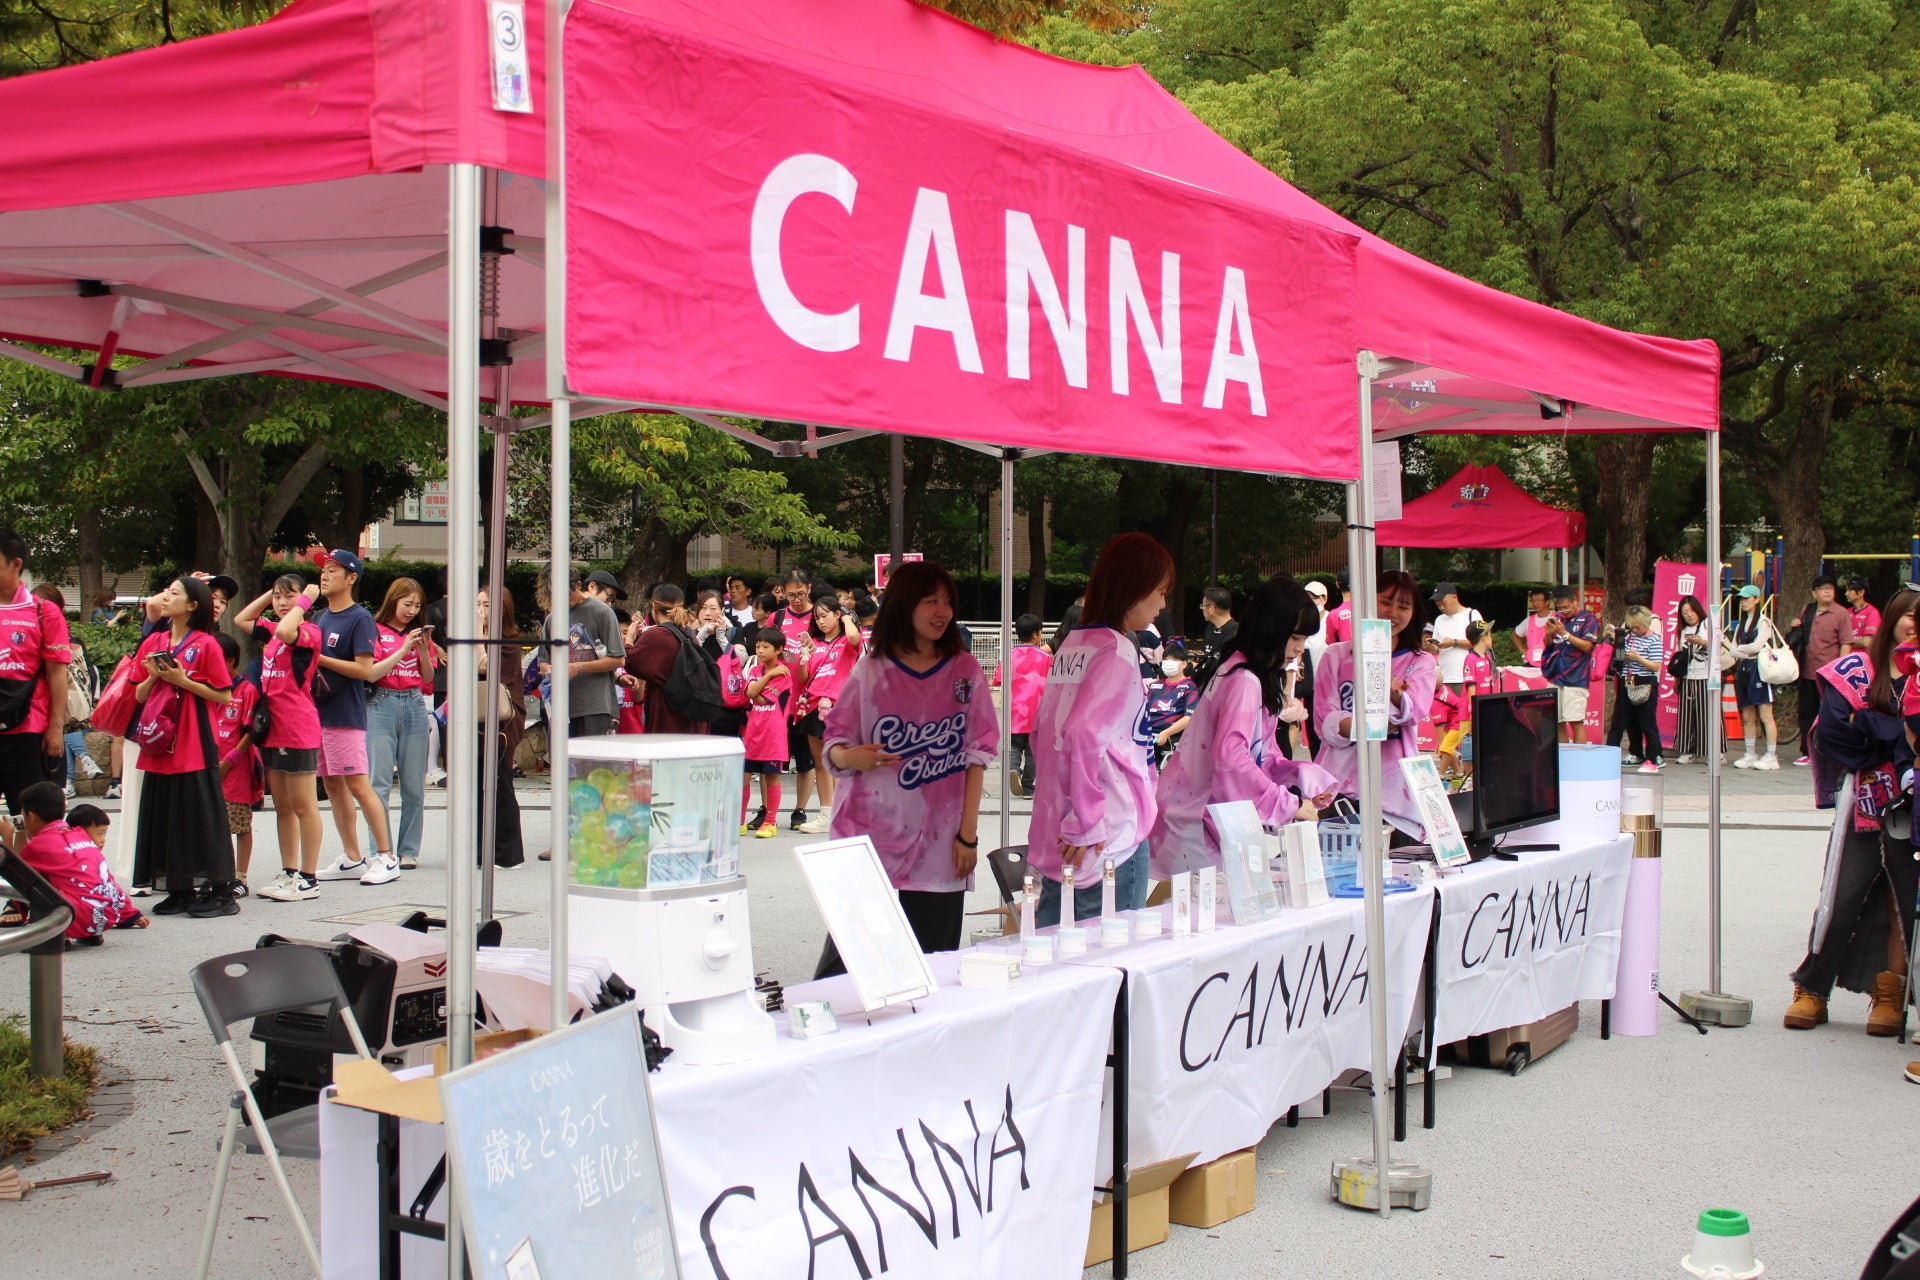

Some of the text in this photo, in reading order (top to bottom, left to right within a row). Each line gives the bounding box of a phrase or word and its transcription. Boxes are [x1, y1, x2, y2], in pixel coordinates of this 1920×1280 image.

[750, 152, 1268, 417] CANNA
[872, 713, 966, 756] Cerezo
[898, 751, 966, 789] Osaka
[690, 771, 723, 783] CANNA
[1461, 871, 1592, 969] CANNA
[531, 1060, 574, 1092] CANNA
[482, 1094, 610, 1191] 歳をとるって
[570, 1139, 642, 1213] 進化だ
[700, 1083, 1031, 1280] CANNA
